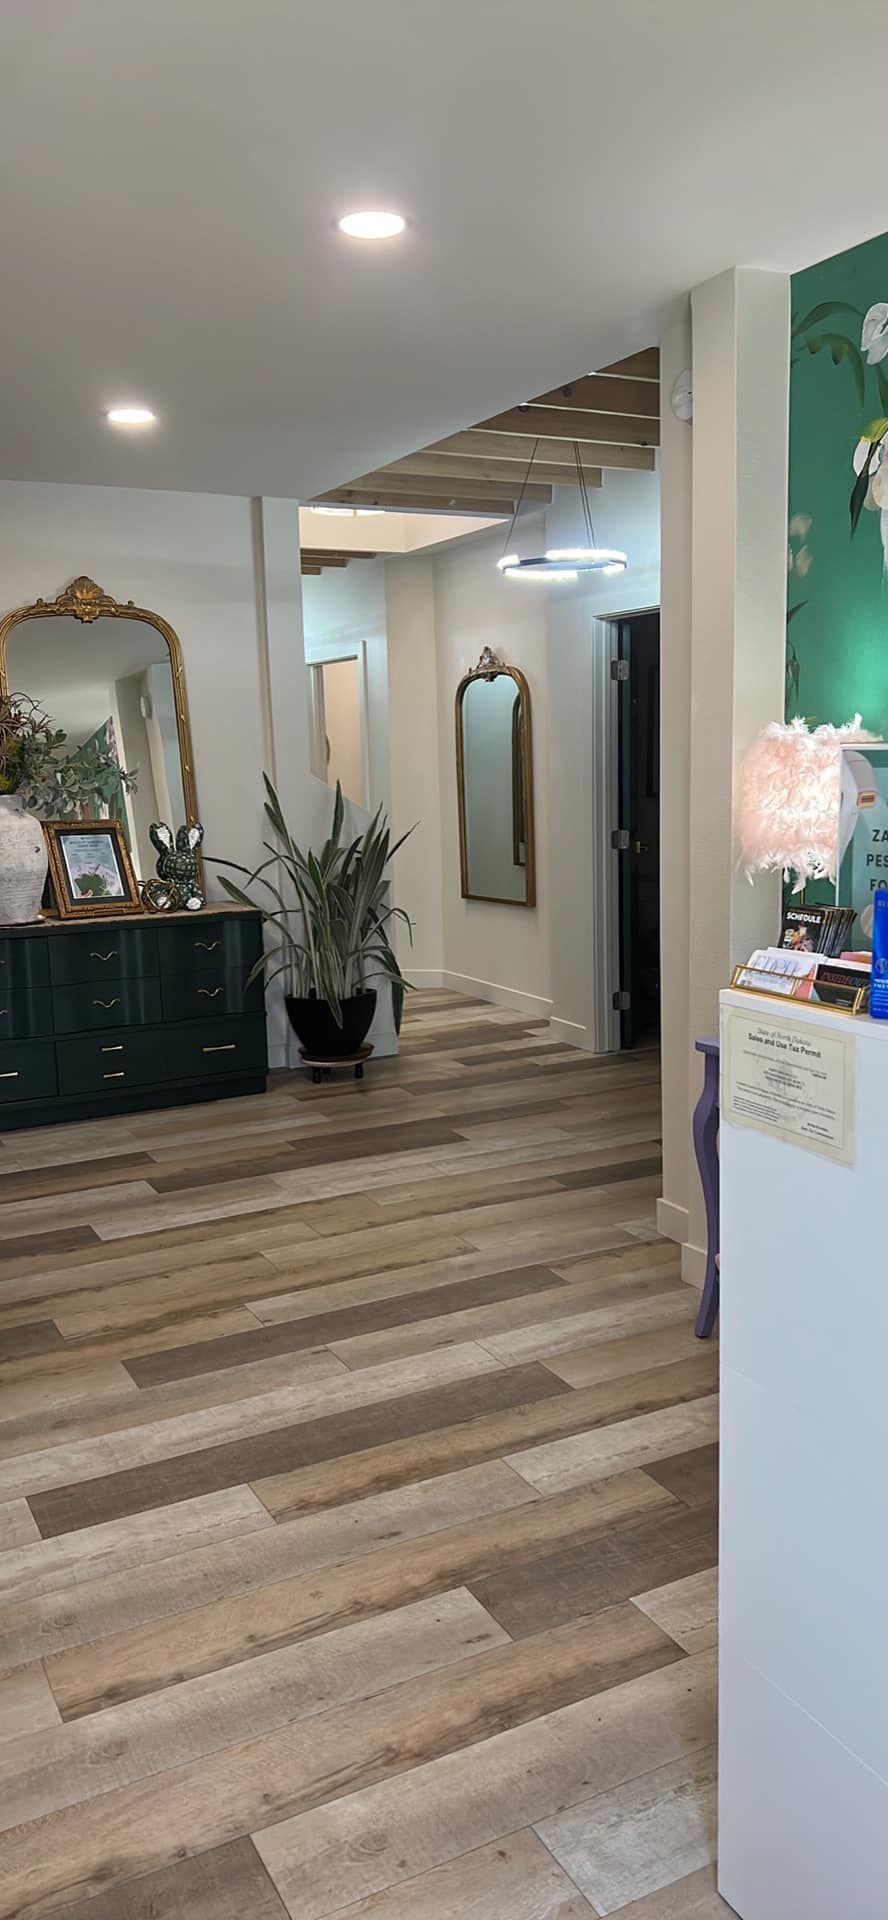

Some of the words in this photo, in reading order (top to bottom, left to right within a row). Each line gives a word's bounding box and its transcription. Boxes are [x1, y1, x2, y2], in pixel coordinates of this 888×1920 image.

[786, 911, 822, 924] SCHEDULE
[748, 1032, 764, 1043] Sales
[764, 1037, 775, 1047] and
[776, 1040, 788, 1050] Use
[788, 1043, 800, 1053] Tax
[800, 1046, 822, 1058] Permit
